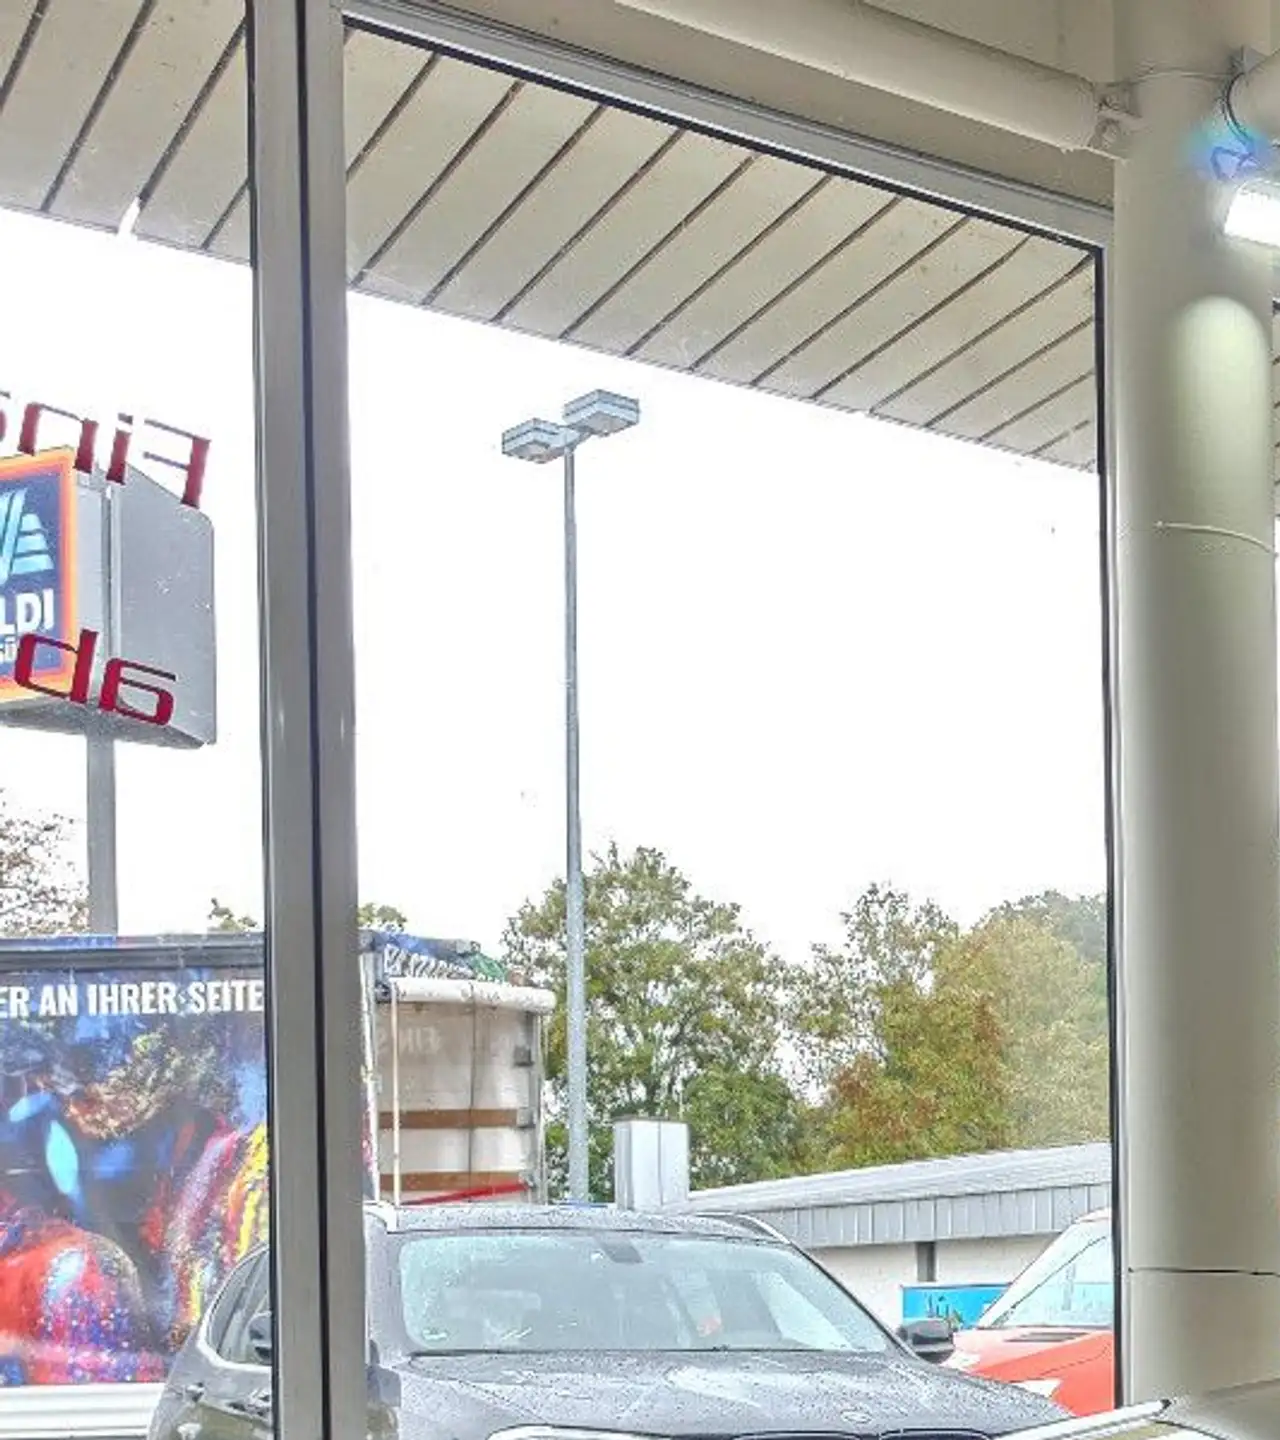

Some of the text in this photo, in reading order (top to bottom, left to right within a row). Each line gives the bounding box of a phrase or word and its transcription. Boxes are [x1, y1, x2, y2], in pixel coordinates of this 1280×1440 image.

[39, 983, 79, 1017] AN
[87, 980, 178, 1015] IHRER
[187, 979, 264, 1014] SEITE
